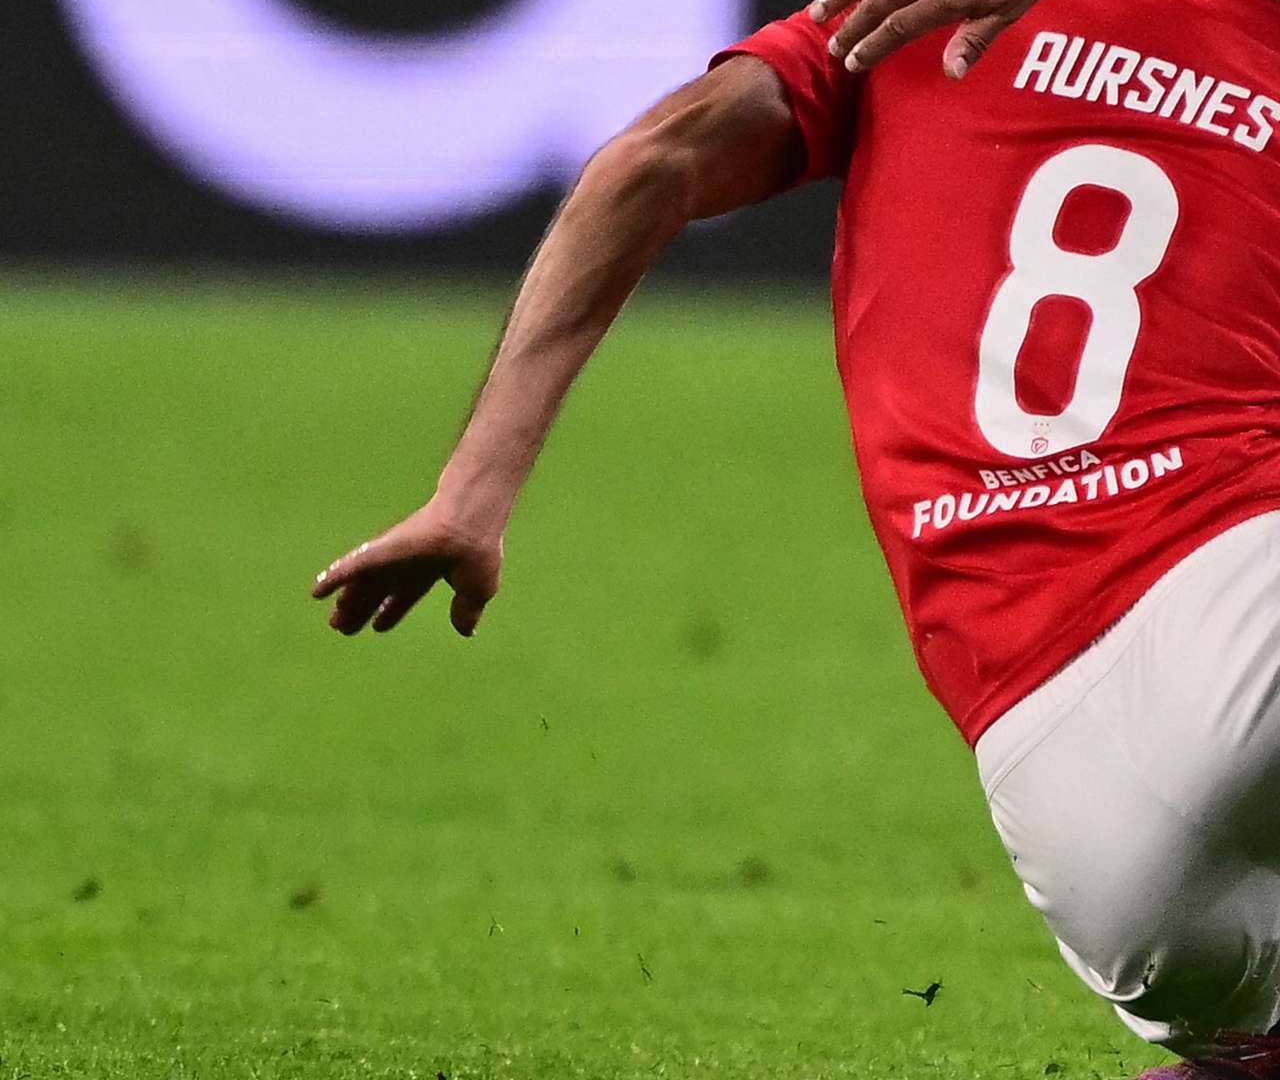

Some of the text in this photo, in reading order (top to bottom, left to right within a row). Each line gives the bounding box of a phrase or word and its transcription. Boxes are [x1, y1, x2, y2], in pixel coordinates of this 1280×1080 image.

[974, 144, 1180, 459] 8
[911, 445, 1184, 538] FOUNDATION
[980, 450, 1102, 490] BENFICA
